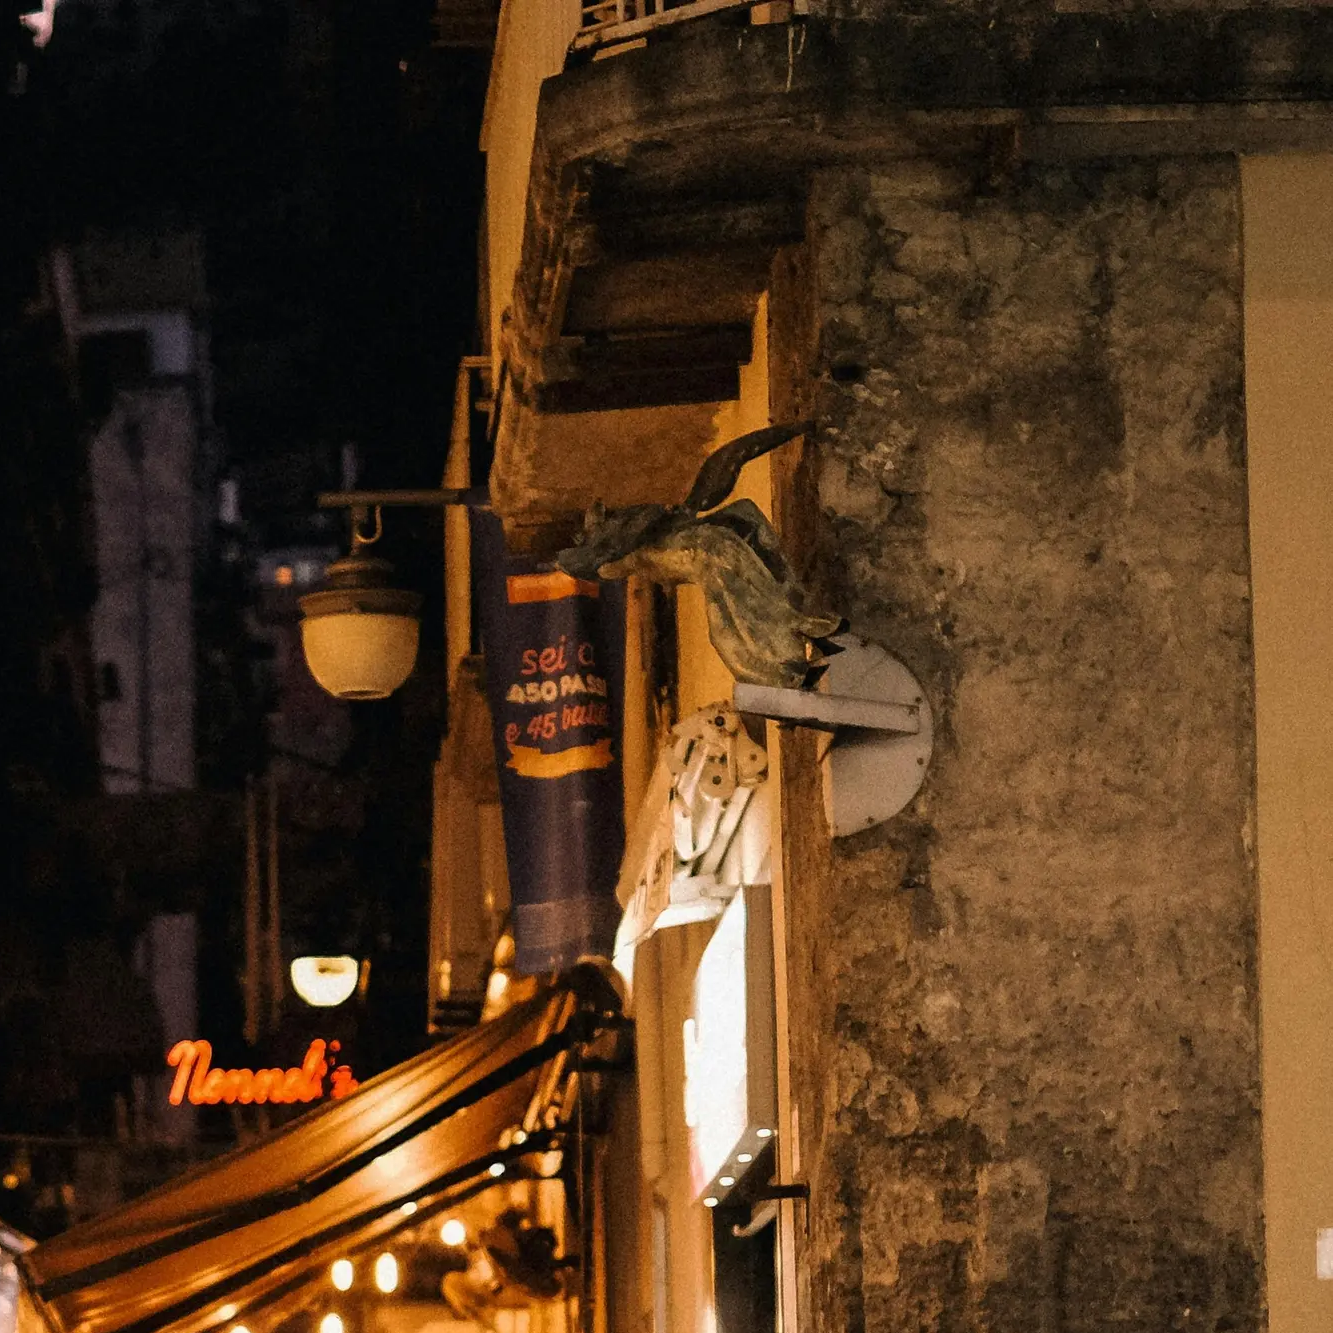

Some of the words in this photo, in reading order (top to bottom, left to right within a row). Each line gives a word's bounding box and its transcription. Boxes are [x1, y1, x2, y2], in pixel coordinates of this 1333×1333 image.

[521, 635, 567, 675] sei
[506, 680, 558, 703] 450
[527, 711, 557, 740] 45
